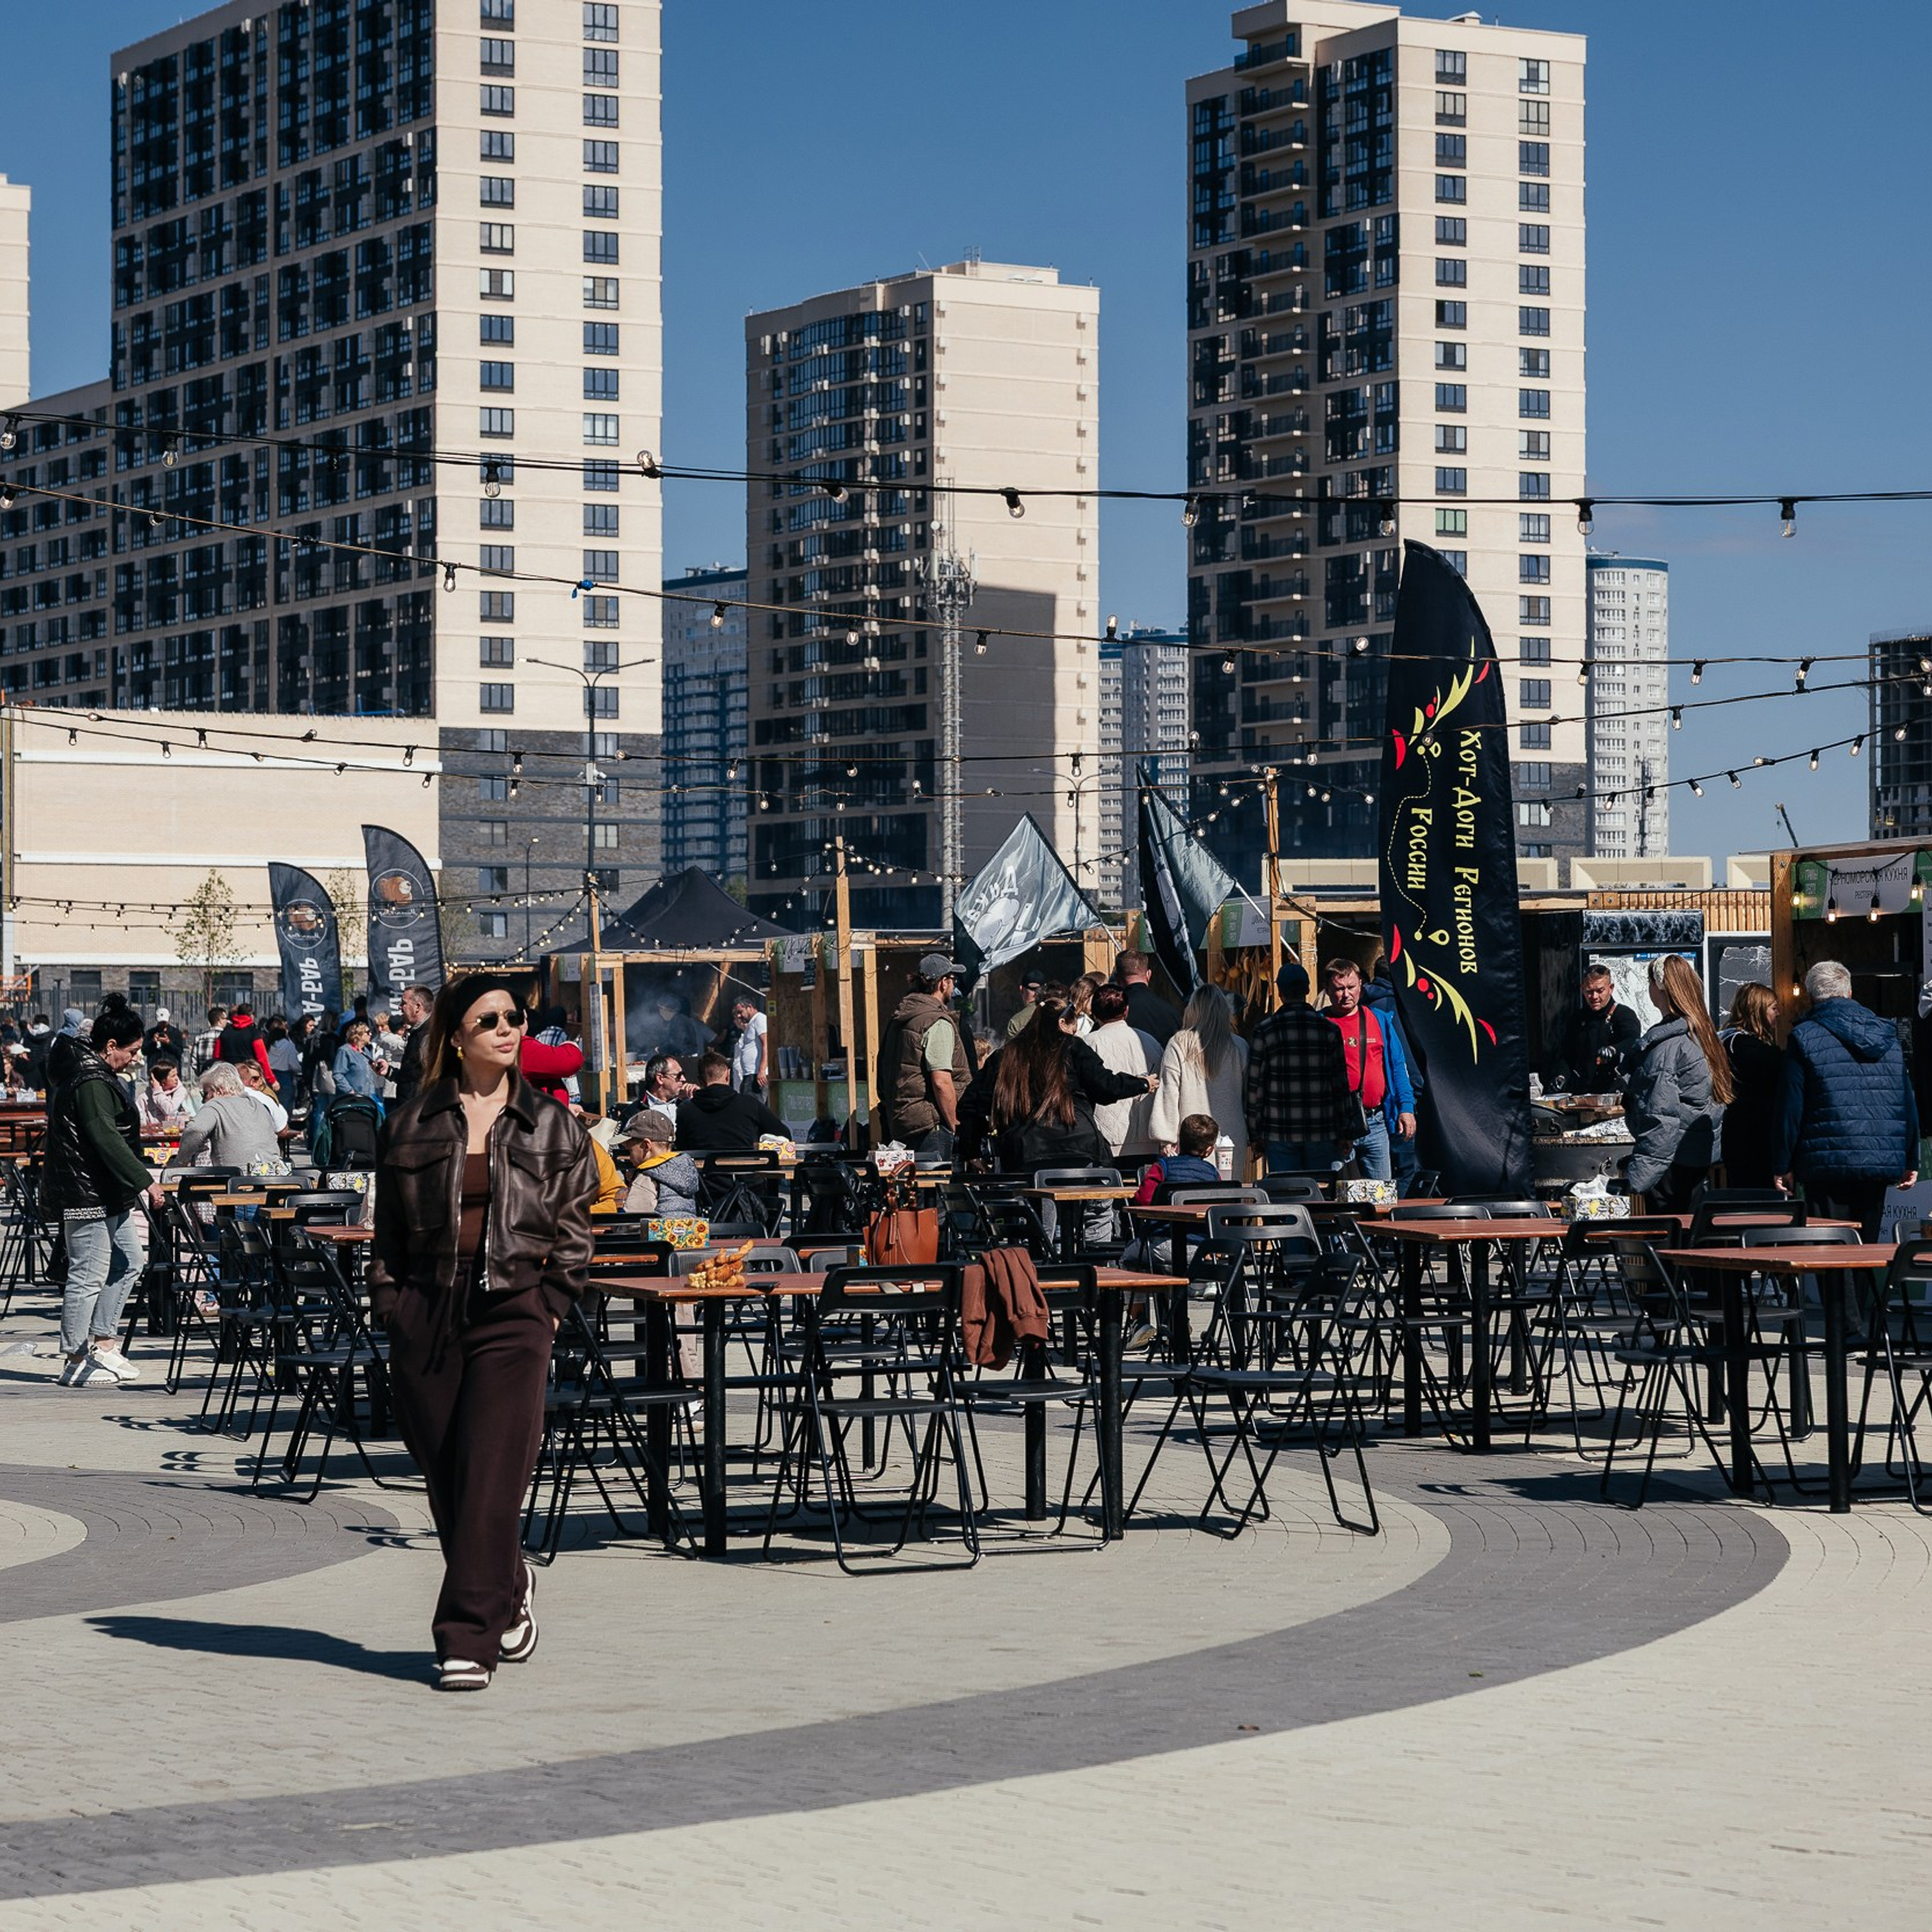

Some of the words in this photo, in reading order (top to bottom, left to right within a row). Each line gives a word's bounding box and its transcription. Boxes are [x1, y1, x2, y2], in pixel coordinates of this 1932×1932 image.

[1829, 869, 1882, 885] ЕРНОМОРСКЯ
[1884, 867, 1908, 881] КУХНЯ
[1894, 1206, 1917, 1219] КУХНЯ
